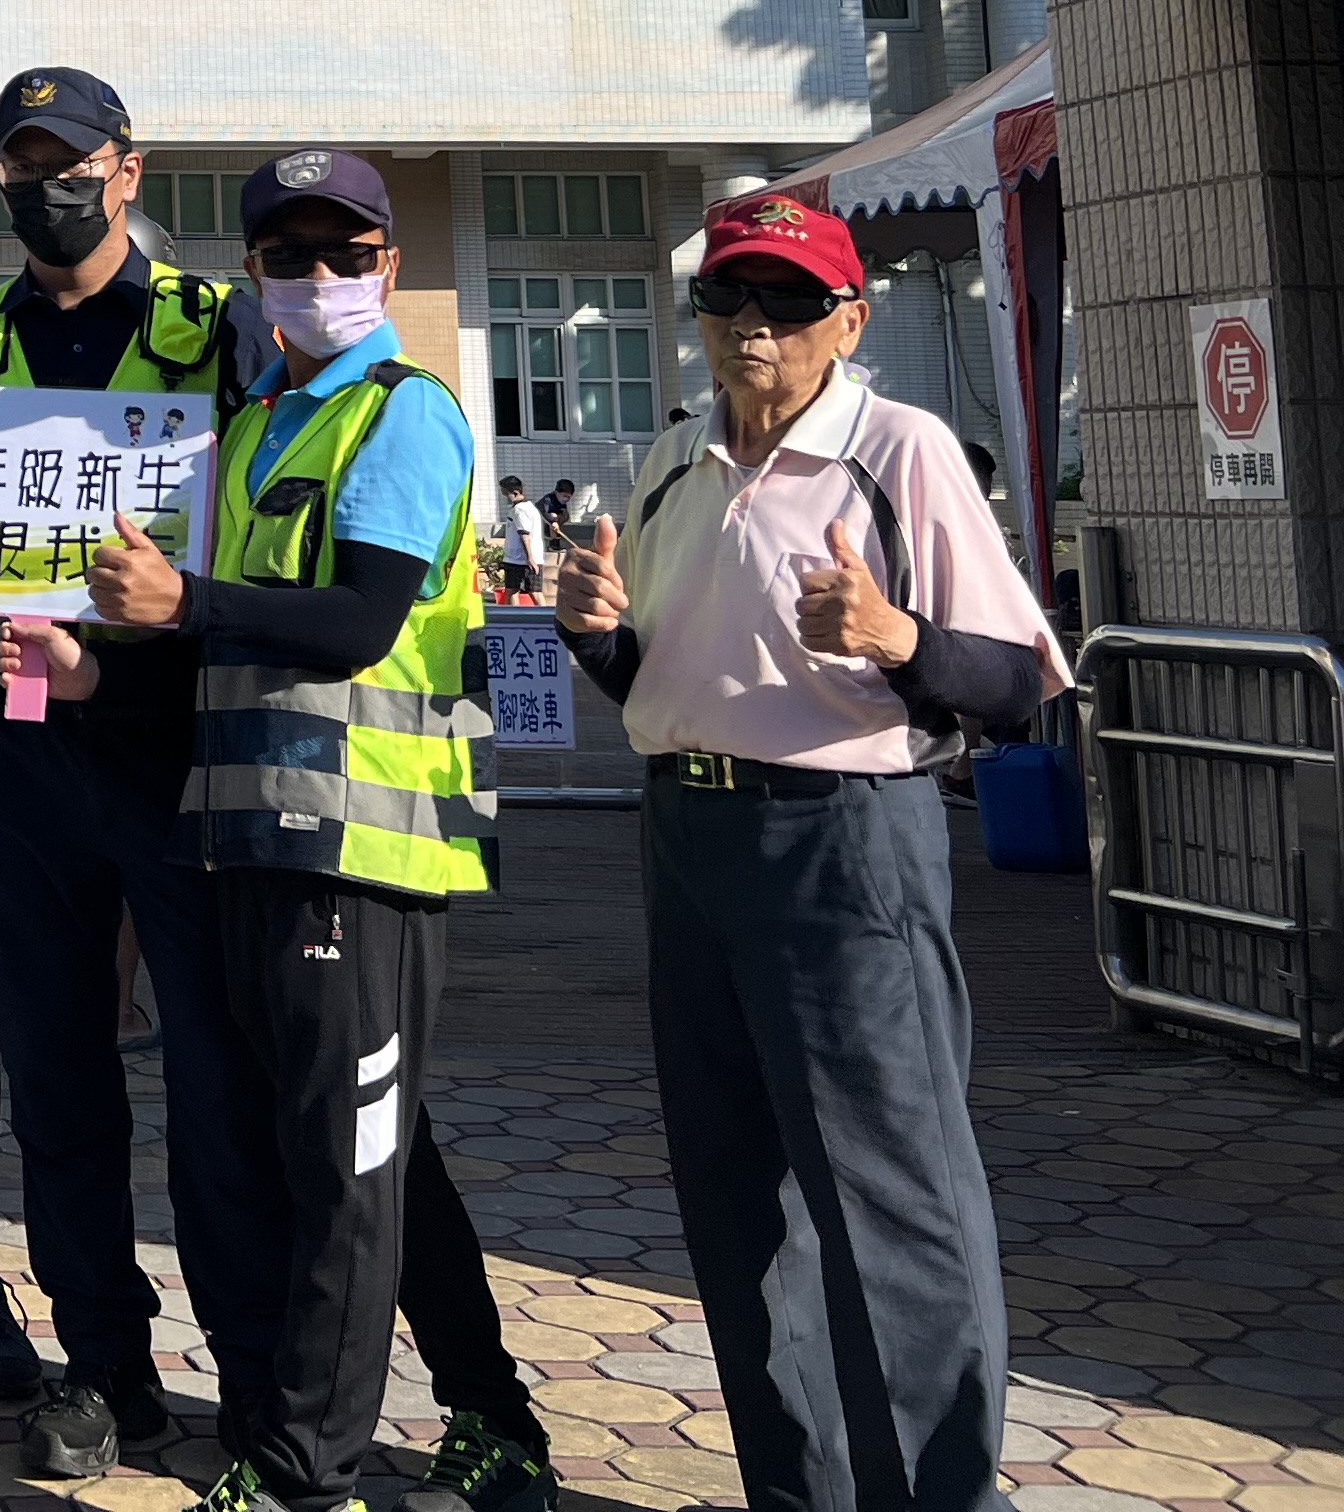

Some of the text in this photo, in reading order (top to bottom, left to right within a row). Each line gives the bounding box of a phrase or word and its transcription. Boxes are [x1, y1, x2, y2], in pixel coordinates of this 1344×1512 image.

[1217, 341, 1255, 414] 停
[1210, 453, 1275, 487] 停車再開
[485, 636, 559, 679] 園全面
[497, 689, 563, 734] 腳踏車
[303, 944, 341, 960] FILA
